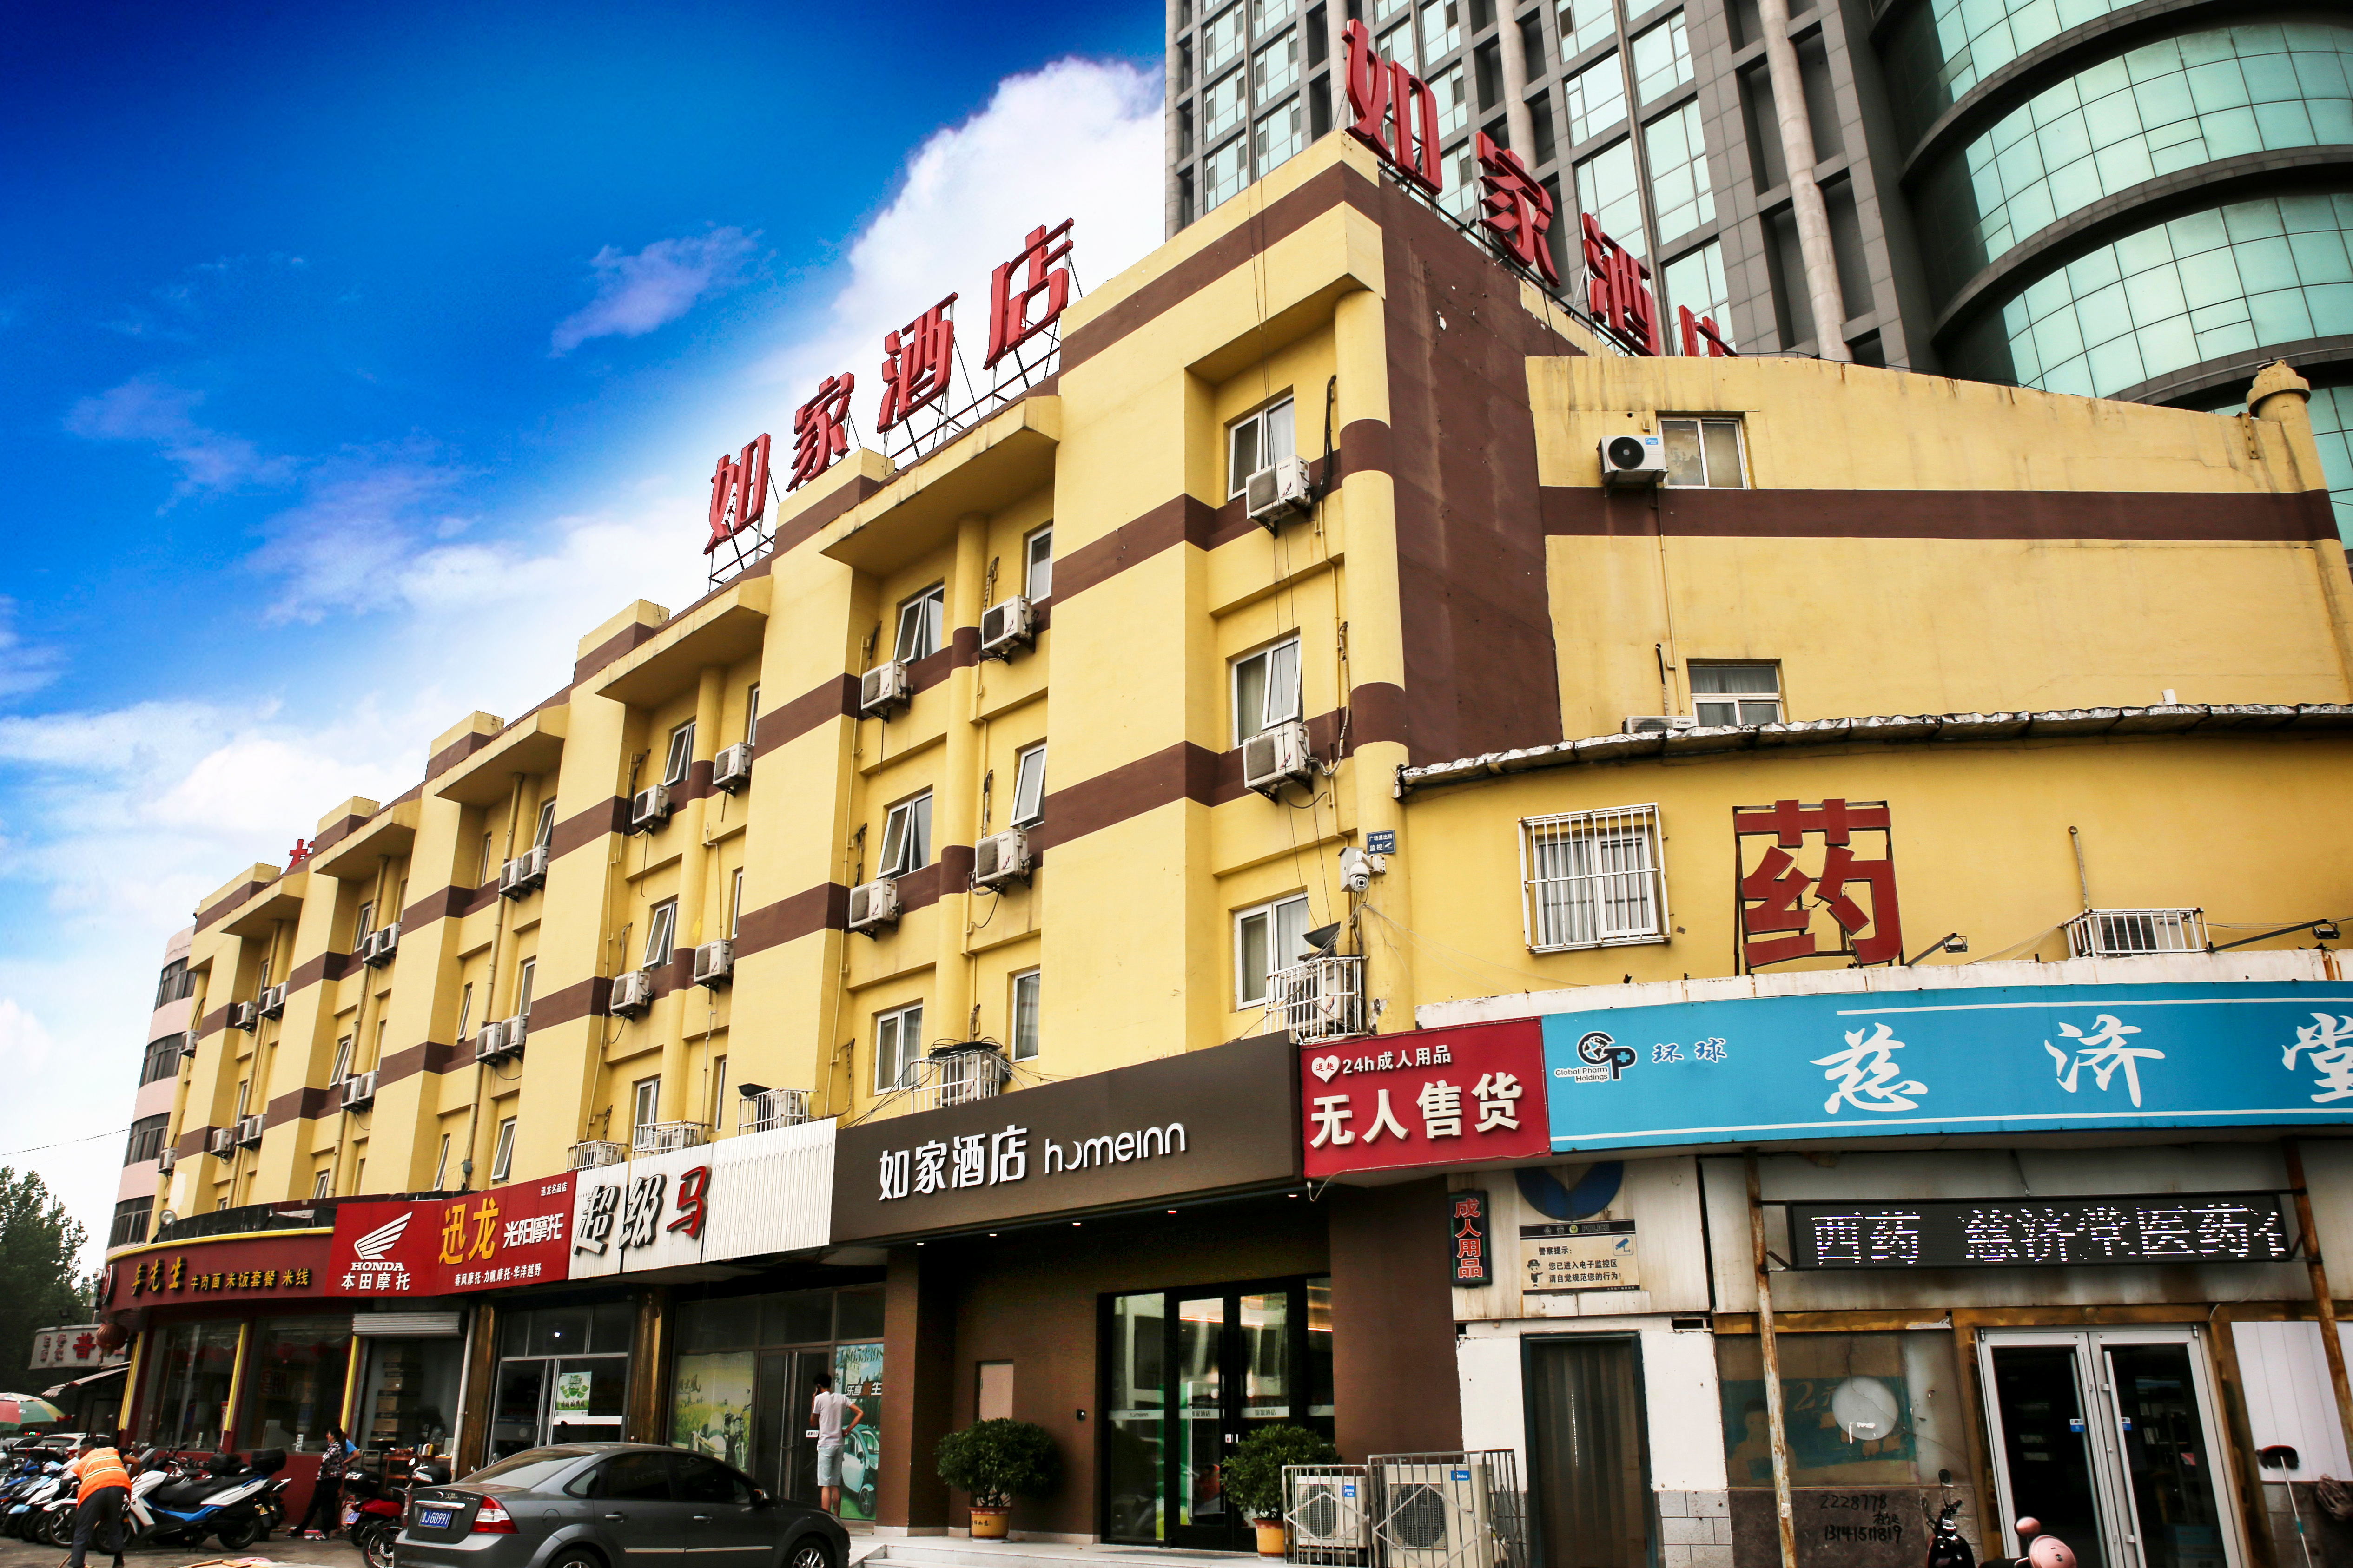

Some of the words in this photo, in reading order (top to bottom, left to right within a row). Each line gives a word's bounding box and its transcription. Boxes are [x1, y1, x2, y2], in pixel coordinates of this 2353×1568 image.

[704, 217, 1074, 554] 如家酒店
[1735, 798, 1903, 967] 药
[1342, 1045, 1452, 1074] 24h成人用品
[1651, 1037, 1727, 1063] 环球
[1810, 1012, 2353, 1114] 慈济堂
[1310, 1072, 1523, 1149] 无人售货
[879, 1124, 1027, 1201] 如家酒店
[1045, 1122, 1187, 1174] homeinn
[541, 1182, 568, 1196] 迅龙名品店
[572, 1166, 712, 1255] 超级马
[1582, 1224, 1610, 1232] POLICE
[439, 1197, 500, 1265] 迅龙
[502, 1212, 564, 1248] 光阳摩托
[1454, 1198, 1483, 1278] 成人用品
[1544, 1225, 1565, 1235] 公安
[1811, 1211, 1920, 1265] 西药
[190, 1273, 222, 1291] 牛肉面
[226, 1270, 275, 1288] 米饭套餐
[282, 1268, 309, 1287] 米线
[341, 1272, 410, 1291] 本田摩托
[350, 1262, 404, 1271] HONDA
[1548, 1259, 1618, 1271] 您已进入电子监控区
[1819, 1493, 1887, 1512] 2228778
